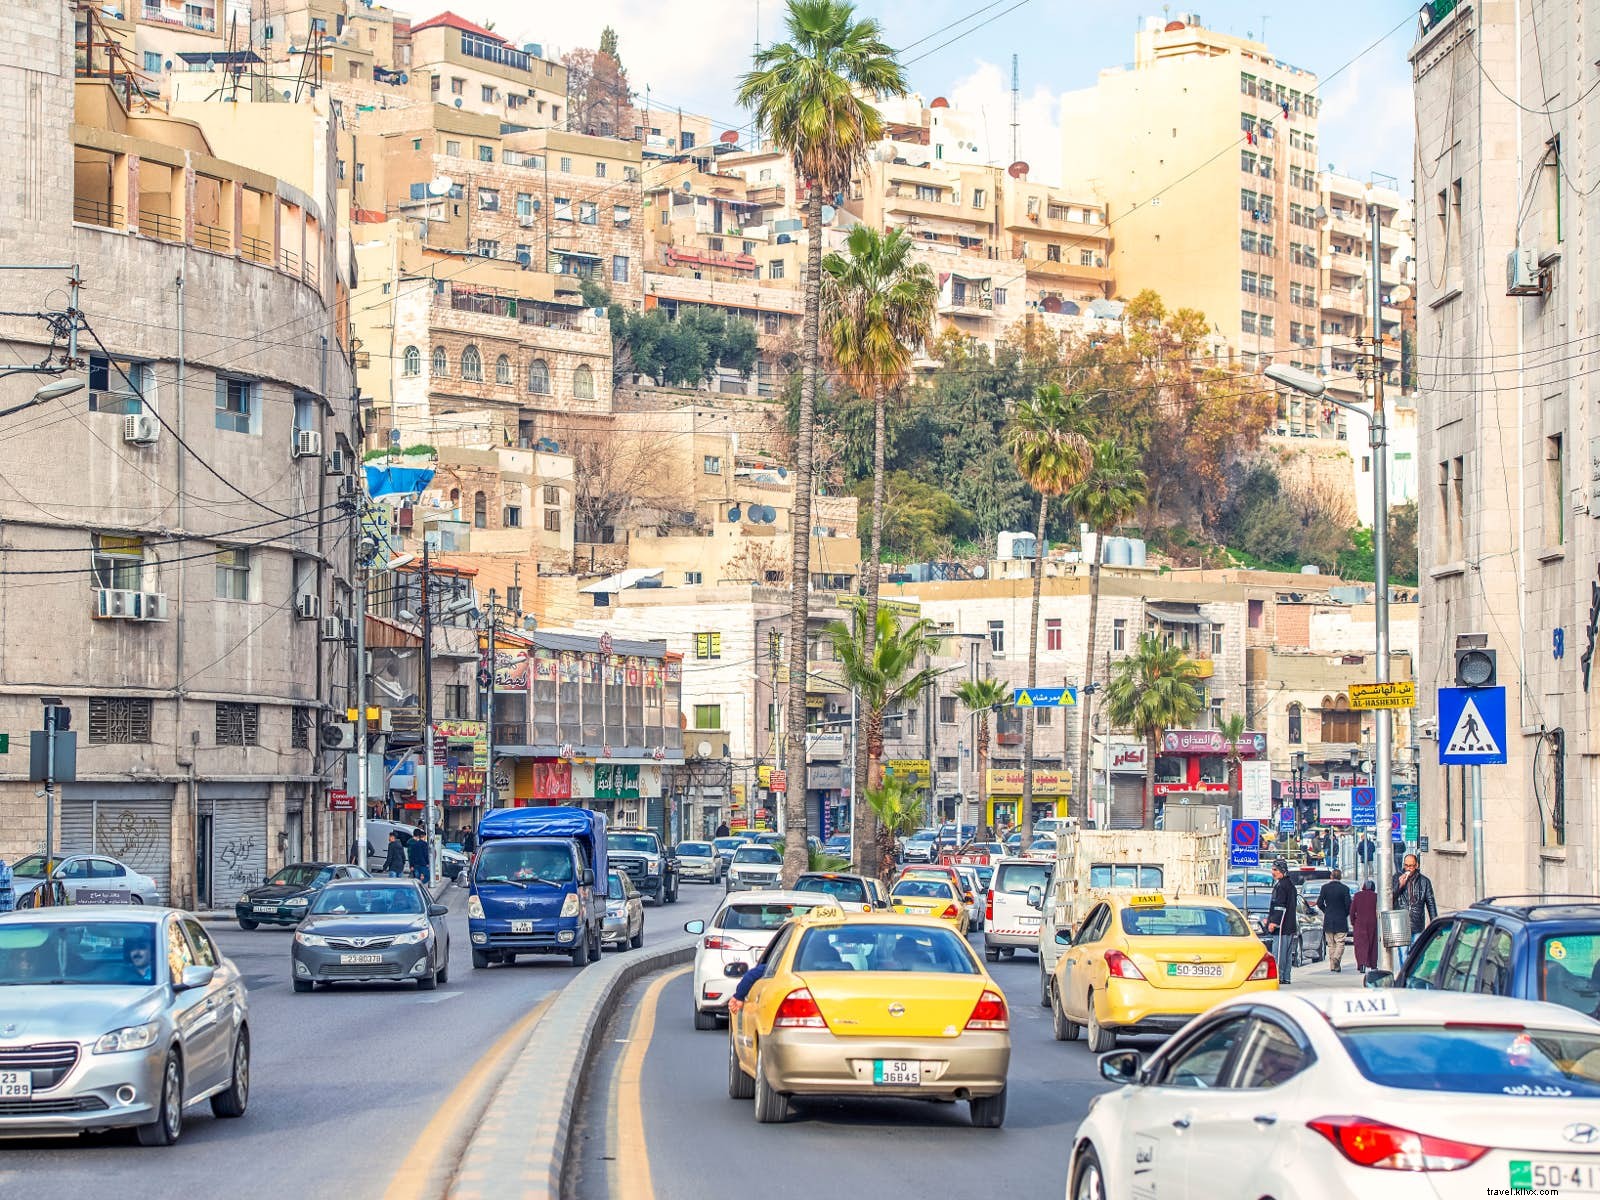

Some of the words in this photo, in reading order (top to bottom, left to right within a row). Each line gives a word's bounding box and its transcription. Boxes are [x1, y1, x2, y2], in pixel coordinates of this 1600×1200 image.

[1353, 685, 1396, 698] الهاشمي
[1048, 695, 1061, 703] ممر
[1344, 998, 1387, 1013] TAXI
[894, 1062, 907, 1072] 50
[2, 1073, 17, 1084] 23
[1534, 1165, 1600, 1188] 50-41
